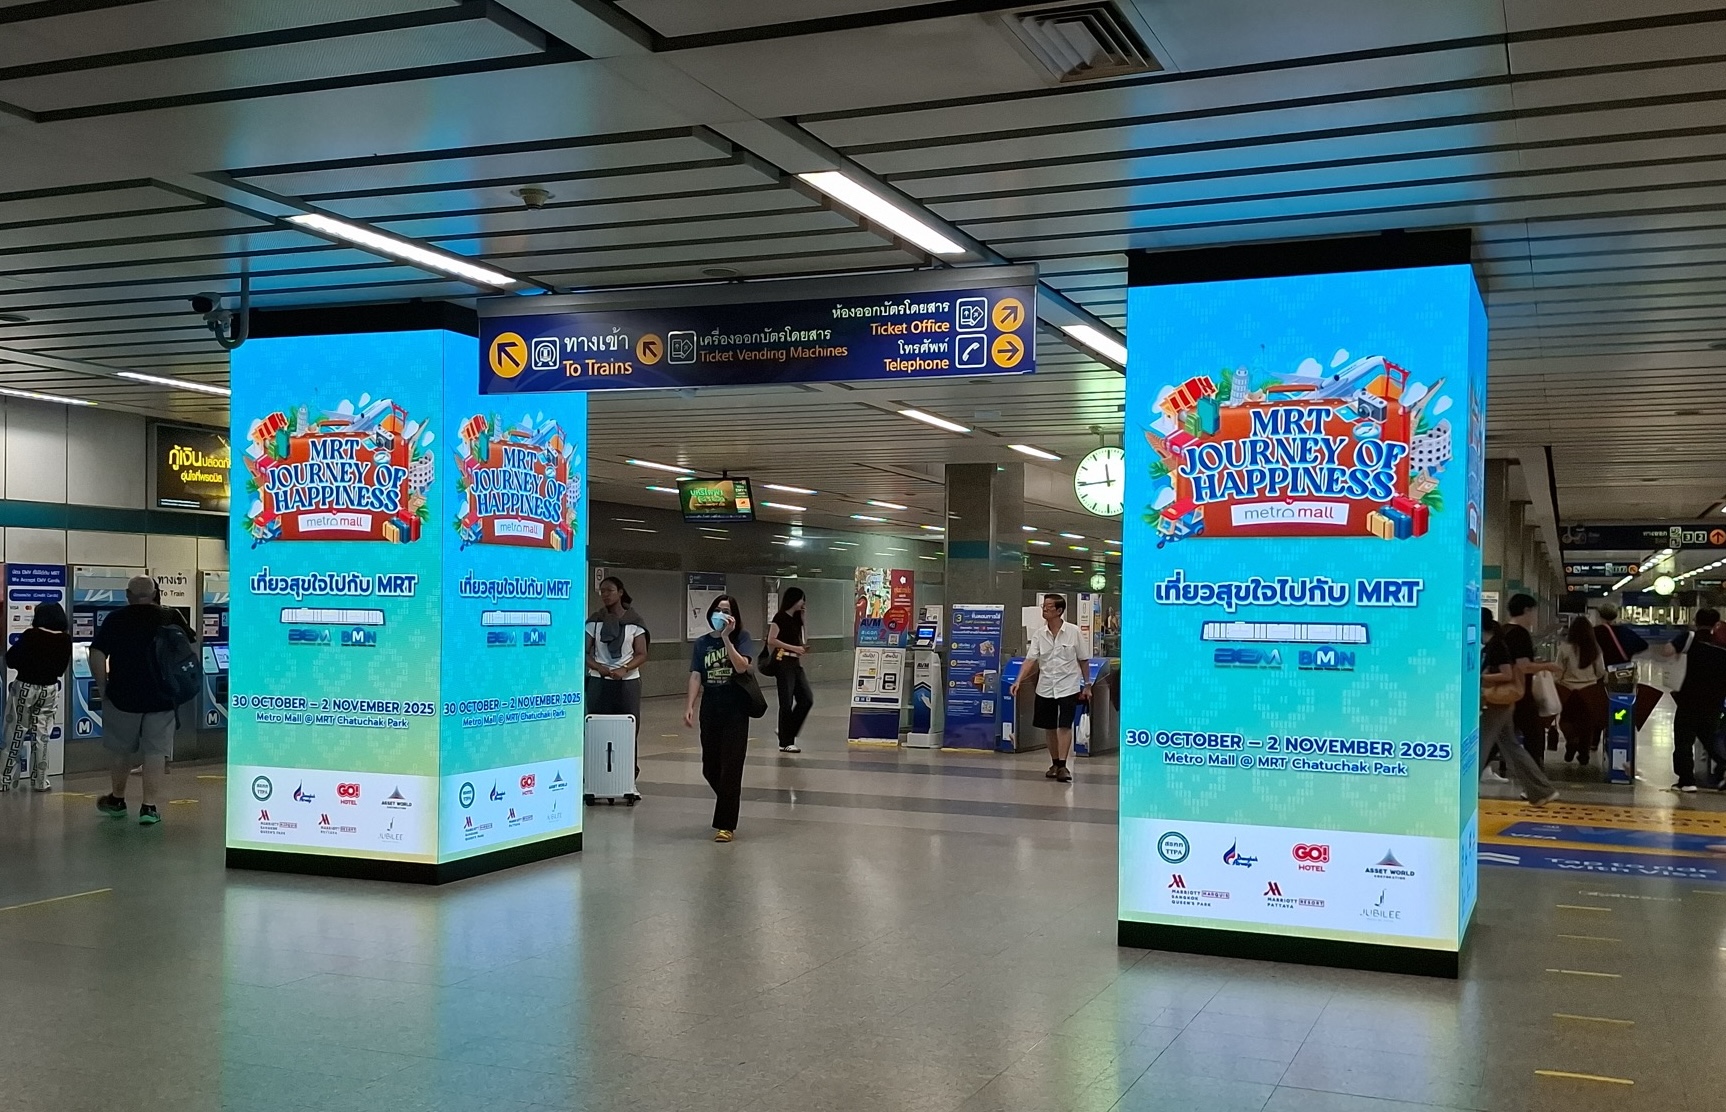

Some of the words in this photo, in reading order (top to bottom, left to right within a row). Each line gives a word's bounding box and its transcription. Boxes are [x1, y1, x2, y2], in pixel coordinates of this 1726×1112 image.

[832, 299, 950, 320] ห้องออกบัตรโดยสาร
[700, 328, 831, 346] เครื่องออกบัตรโดยสาร
[871, 322, 907, 336] Ticket
[911, 320, 950, 334] Office
[564, 327, 629, 353] ทางเข้า
[898, 338, 948, 356] โทรศัพท์
[700, 350, 733, 364] Ticket
[738, 348, 786, 364] Vending
[790, 346, 848, 360] Machines
[884, 357, 949, 374] Telephone
[563, 360, 581, 377] To
[586, 358, 633, 376] Trains
[1251, 407, 1332, 438] MRT
[310, 438, 360, 462] MRT
[503, 447, 537, 472] MRT
[1180, 436, 1347, 476] JOURNEY
[1354, 439, 1408, 474] OF
[266, 461, 370, 492] JOURNEY
[375, 464, 407, 489] OF
[471, 468, 543, 495] JOURNEY
[545, 479, 566, 501] OF
[1192, 466, 1397, 503] HAPPINESS
[272, 484, 400, 514] HAPPINESS
[476, 492, 561, 524] HAPPINESS
[158, 572, 187, 585] ทางเข้า
[250, 566, 372, 600] เที่ยวสุขใจไปกับ
[377, 575, 418, 596] MRT
[459, 569, 543, 604] เที่ยวสุขใจไปกับ
[546, 579, 571, 598] MRT
[170, 589, 185, 597] Train
[1154, 569, 1348, 612] เที่ยวสุขใจไปกับ
[1355, 579, 1423, 606] MRT
[232, 695, 248, 708] 30
[251, 696, 306, 709] OCTOBER
[321, 699, 330, 711] 2
[333, 699, 400, 714] NOVEMBER
[404, 702, 436, 716] 2025
[443, 702, 456, 715] 30
[459, 699, 500, 713] OCTOBER
[510, 698, 516, 709] 2
[517, 694, 561, 708] NOVEMBER
[562, 692, 581, 705] 2025
[256, 712, 282, 722] Metro
[284, 713, 302, 723] Mall
[304, 714, 313, 724] @
[315, 715, 335, 724] MRT
[337, 716, 385, 727] Chatuchak
[387, 718, 409, 728] Park
[462, 717, 482, 727] Metro
[483, 715, 497, 725] Mall
[505, 713, 519, 722] MRT
[520, 710, 552, 721] Chatuchak
[552, 709, 565, 718] Park
[1125, 730, 1150, 747] 30
[1155, 731, 1244, 750] OCTOBER
[1267, 736, 1280, 752] 2
[1285, 737, 1393, 758] NOVEMBER
[1399, 742, 1453, 761] 2025
[1163, 752, 1203, 765] Metro
[1208, 754, 1236, 767] Mall
[1240, 755, 1253, 768] @
[1257, 756, 1288, 769] MRT
[1291, 756, 1369, 774] Chatuchak
[1373, 762, 1408, 777] Park
[338, 784, 360, 797] GO!
[520, 774, 536, 788] GO!
[1294, 845, 1328, 863] GO!
[1298, 864, 1326, 873] HOTEL
[1365, 867, 1387, 875] ASSET
[1389, 869, 1415, 877] WORLD
[1360, 908, 1401, 920] JUBILEE
